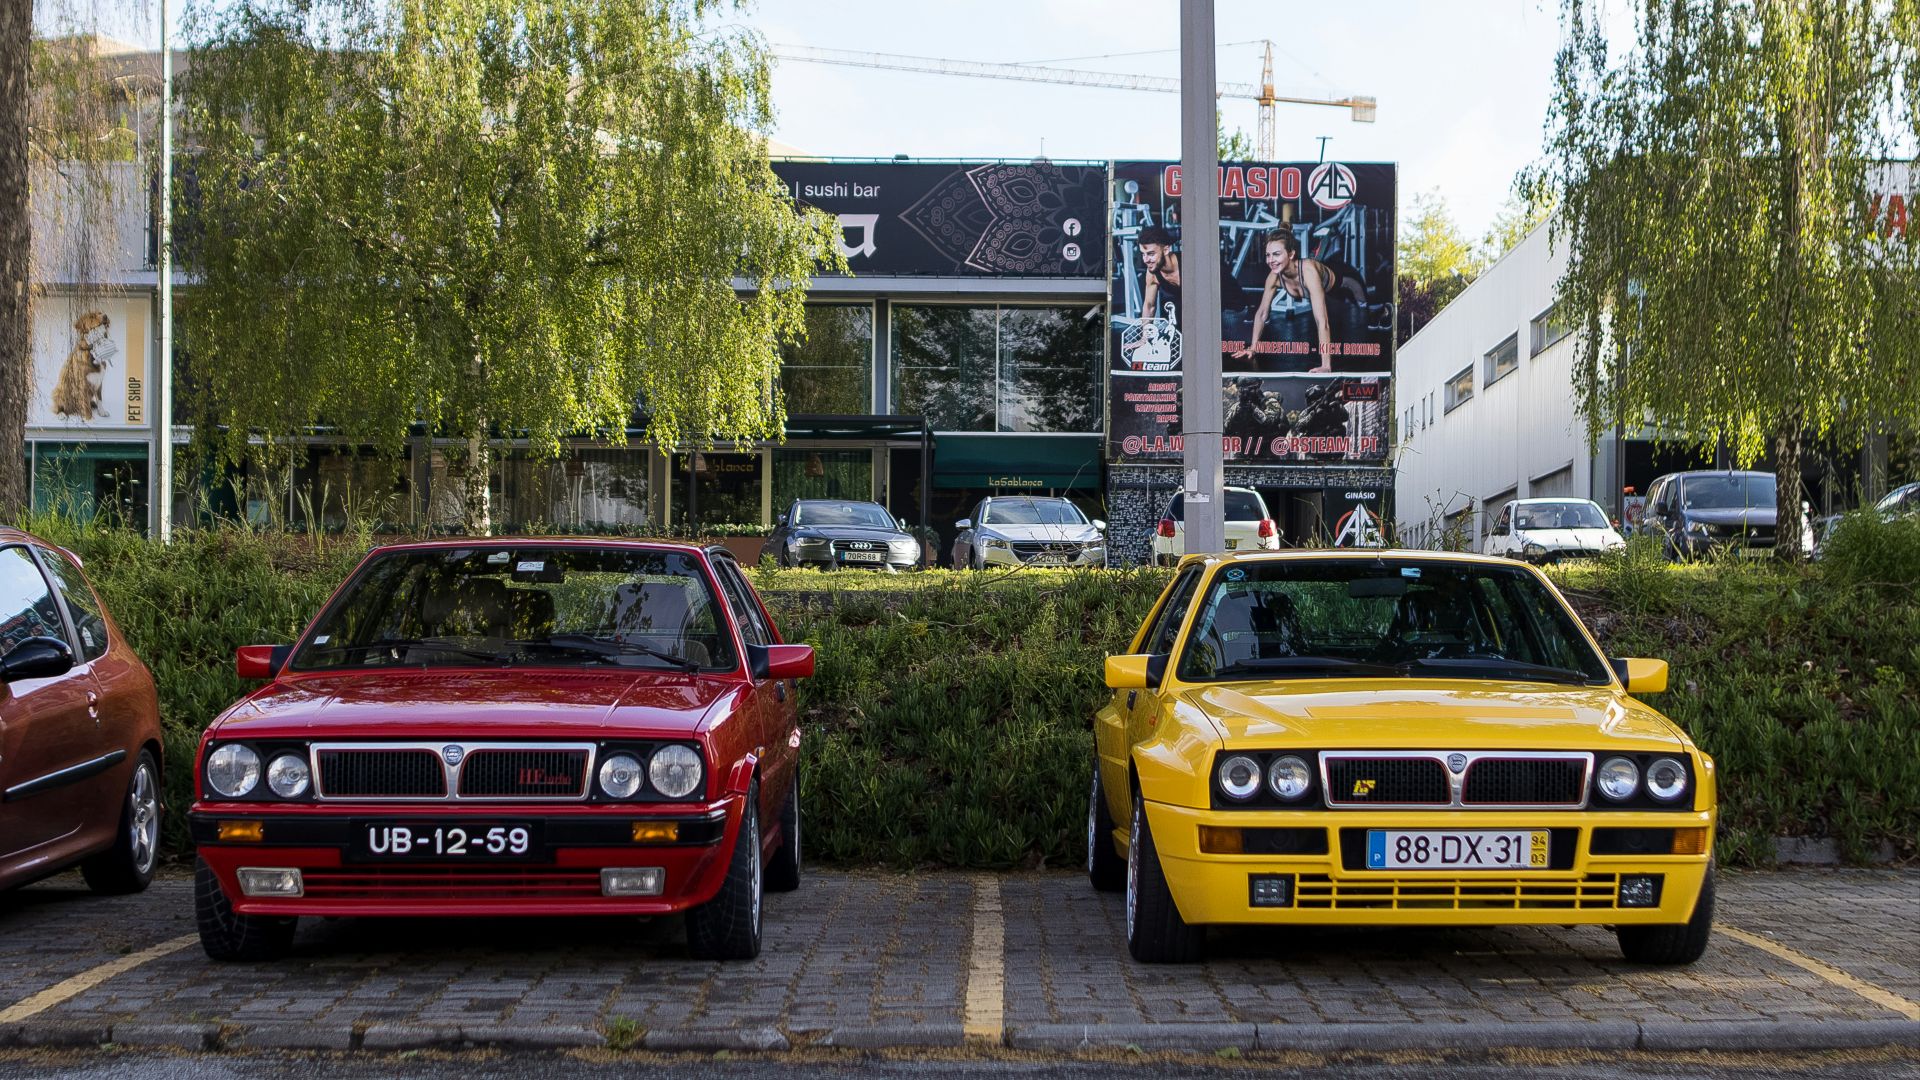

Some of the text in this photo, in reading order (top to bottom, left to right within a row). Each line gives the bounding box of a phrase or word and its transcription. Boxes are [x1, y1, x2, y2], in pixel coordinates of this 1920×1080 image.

[1165, 165, 1301, 199] GASIO
[804, 182, 848, 197] sushi
[853, 182, 880, 197] bar
[1255, 341, 1310, 355] WRESTLING
[1319, 342, 1342, 355] KICK
[1343, 343, 1381, 356] BOXING
[1148, 383, 1177, 392] AIRSOFT
[1347, 387, 1375, 397] LAW
[128, 376, 141, 422] PET SHOP
[1345, 491, 1376, 500] GINÁSIO
[369, 827, 529, 855] UB-12-59
[1531, 835, 1546, 846] 94
[1374, 853, 1381, 862] P
[1531, 854, 1546, 864] 03
